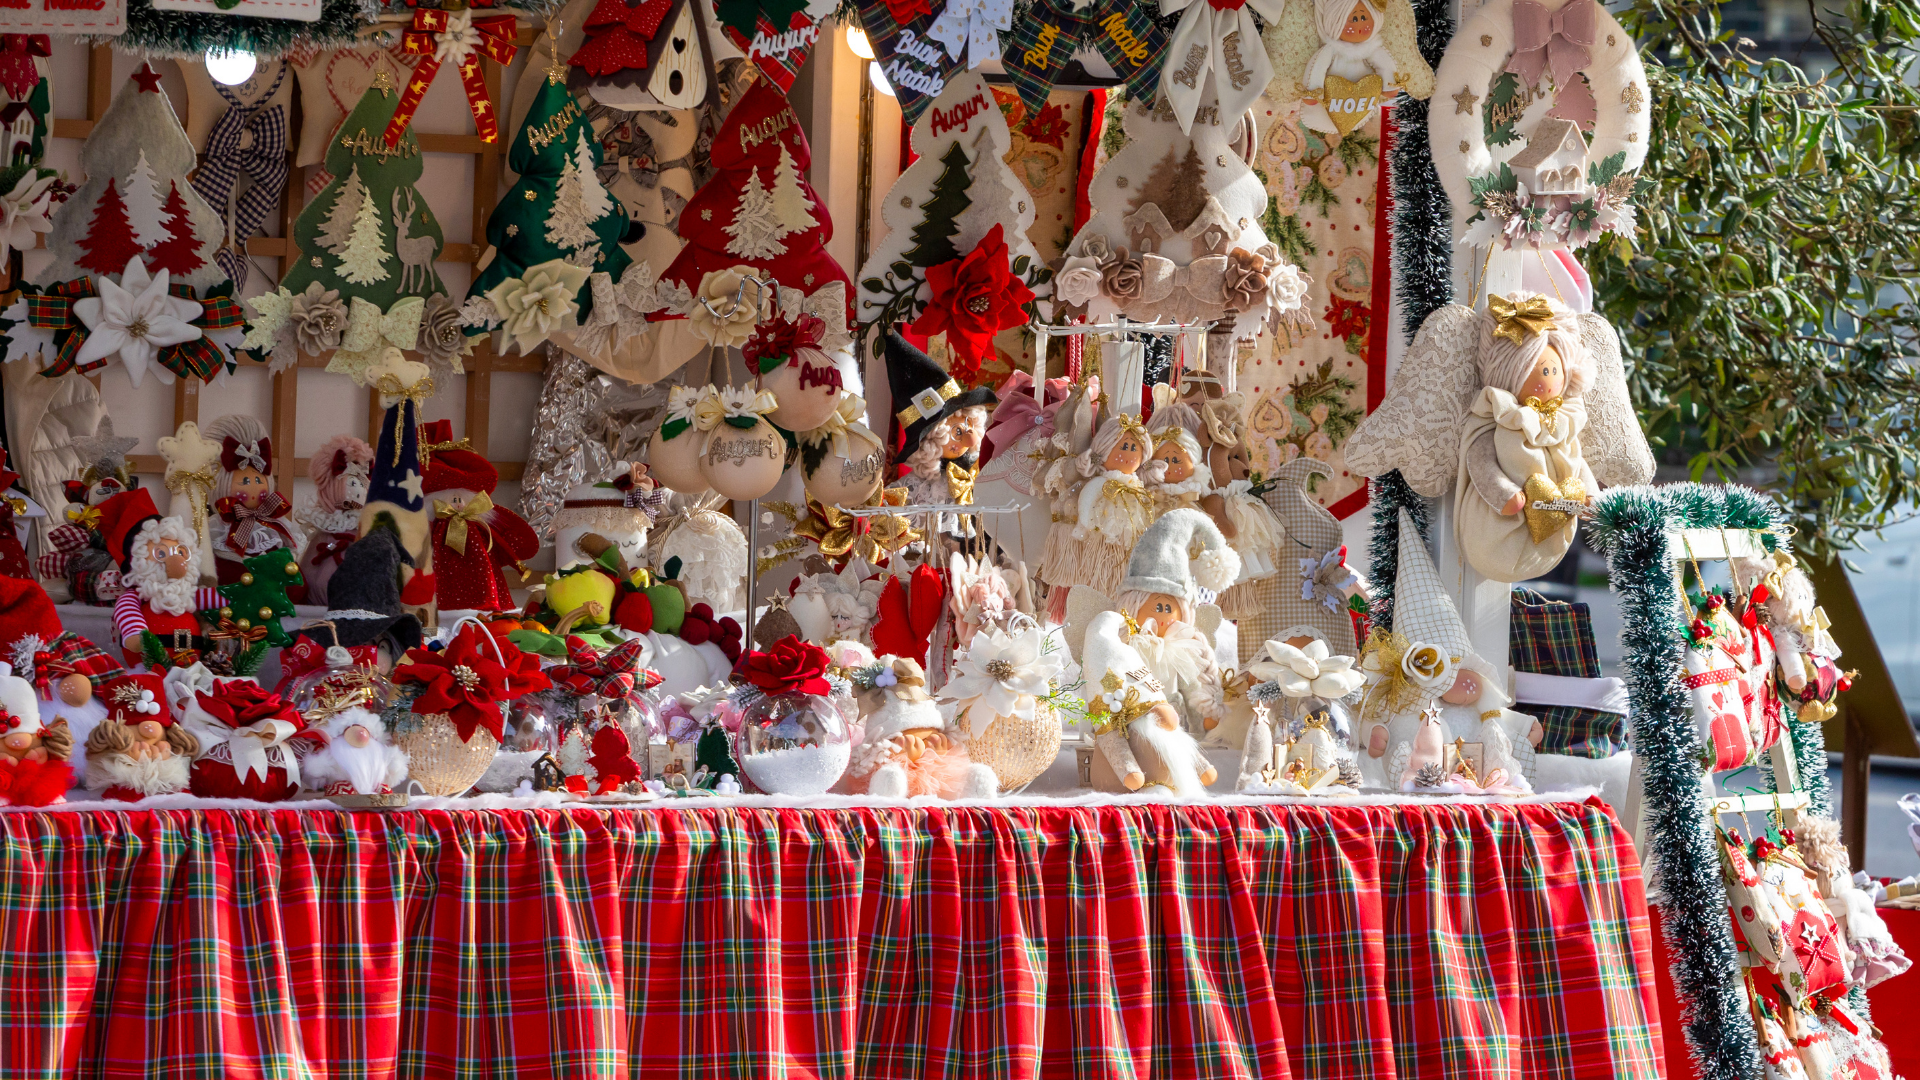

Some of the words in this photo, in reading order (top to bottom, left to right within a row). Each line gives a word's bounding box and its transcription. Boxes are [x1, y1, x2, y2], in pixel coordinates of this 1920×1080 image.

[748, 19, 819, 60] Auguri
[894, 29, 942, 67] Buon
[1024, 23, 1060, 70] Buon
[1099, 12, 1148, 67] Natale
[884, 60, 944, 97] Natale
[527, 91, 582, 155] Auguri
[740, 98, 797, 153] Auguri
[931, 84, 989, 137] Auguri
[1328, 97, 1376, 113] NOEL
[709, 434, 777, 466] Auguri
